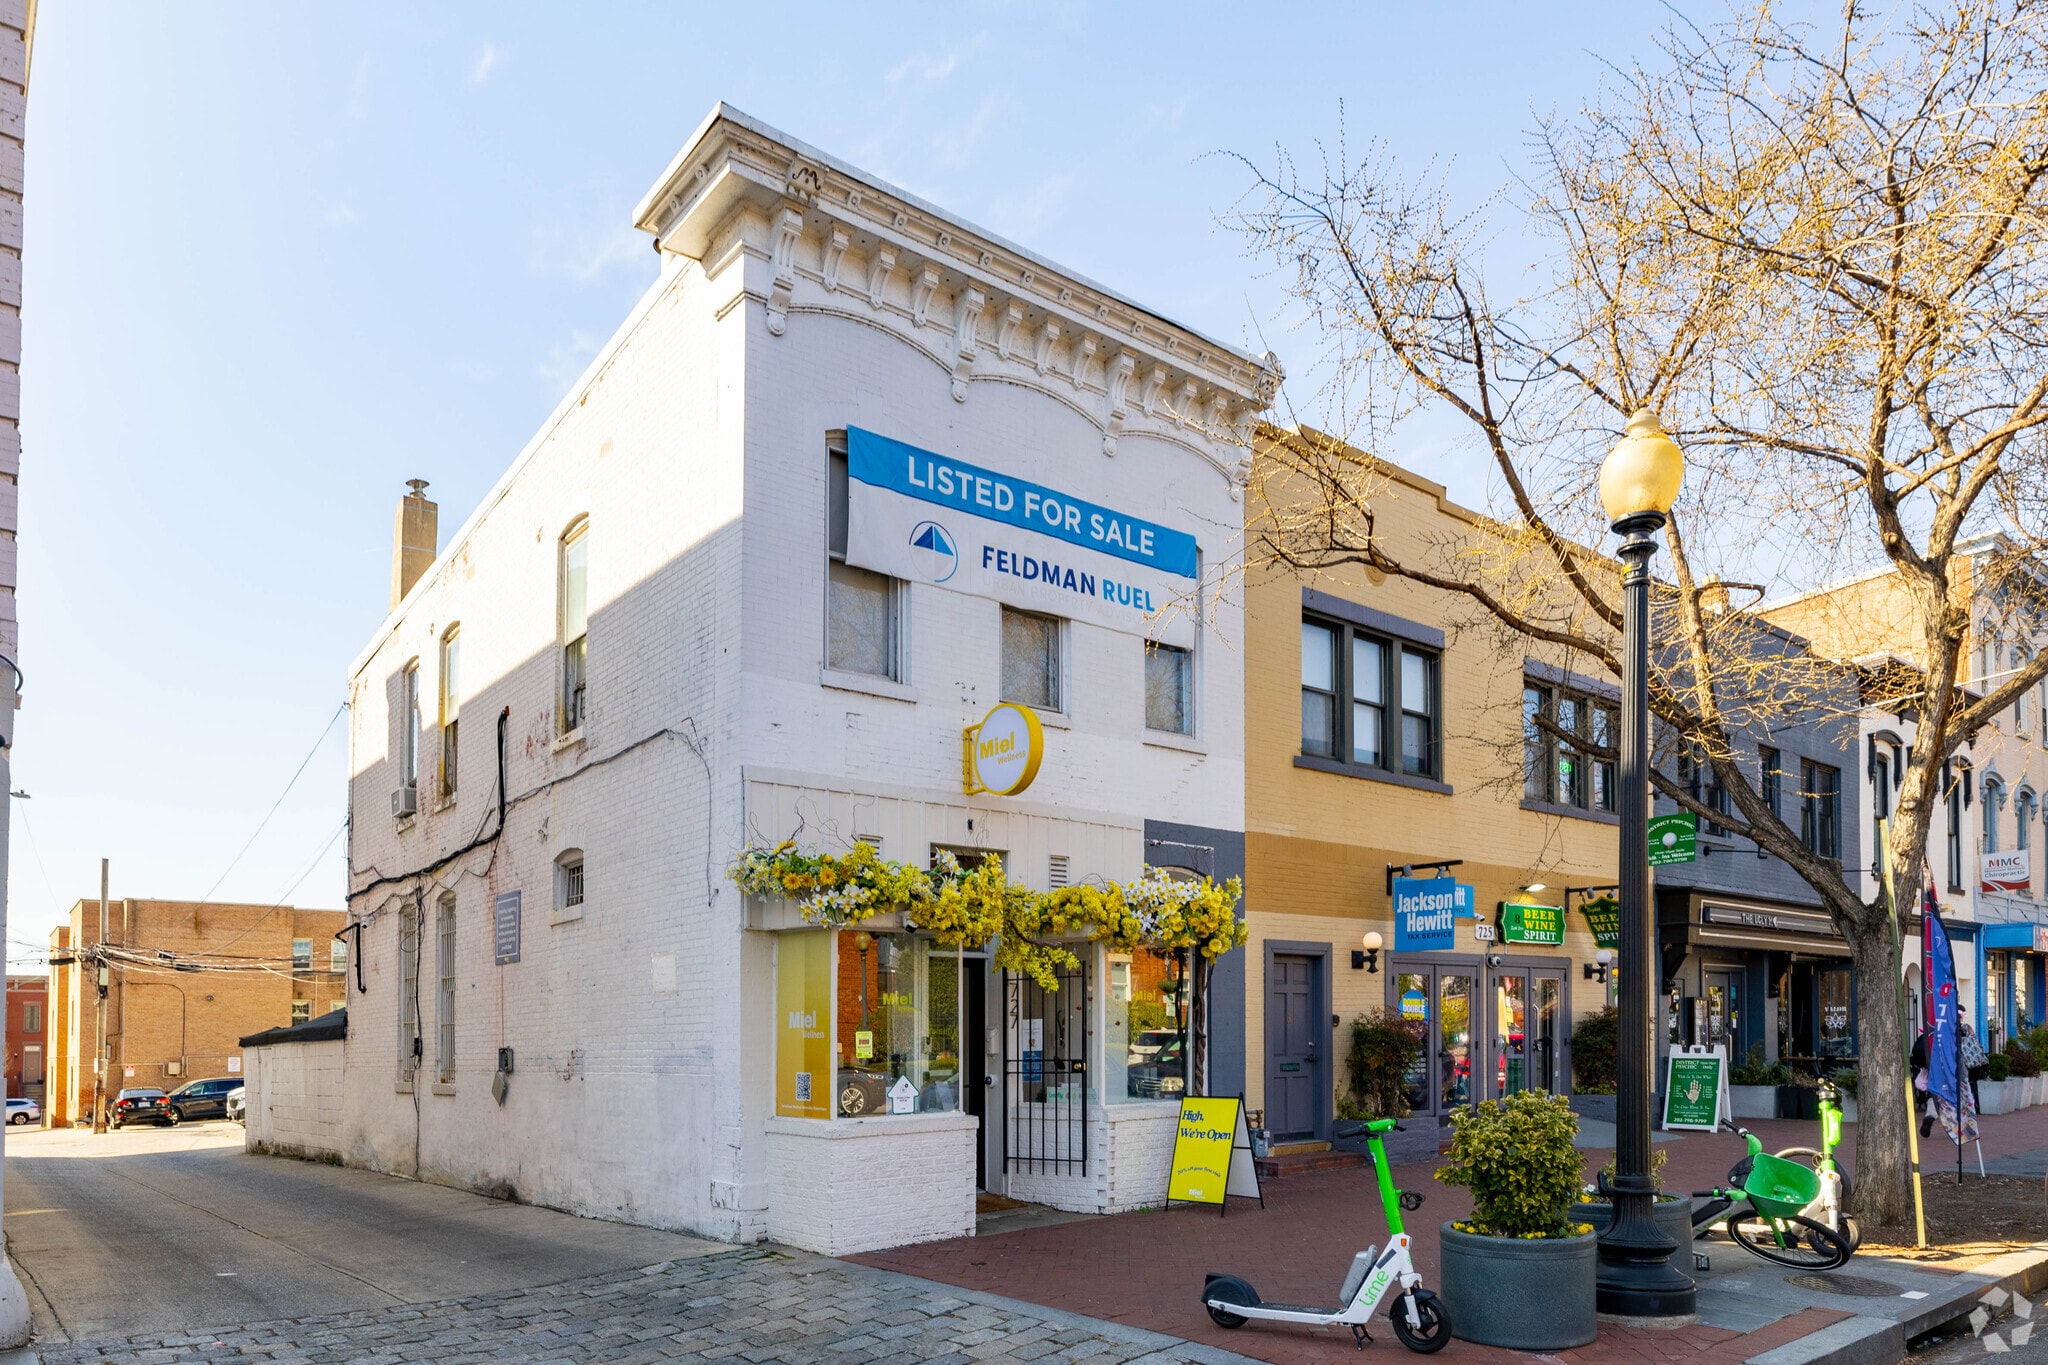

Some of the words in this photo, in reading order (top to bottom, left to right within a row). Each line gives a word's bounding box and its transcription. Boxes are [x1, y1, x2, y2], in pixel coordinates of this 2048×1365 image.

[908, 456, 1014, 512] LISTED
[1024, 491, 1081, 534] FOR
[1090, 514, 1155, 556] SALE
[982, 545, 1096, 597] FELDMAN
[1102, 579, 1155, 612] RUEL
[980, 731, 1015, 760] Miel
[1988, 857, 2020, 868] MMC
[1985, 870, 2026, 878] Chiropractic
[1397, 891, 1453, 913] Jackson
[1406, 909, 1453, 932] Hewitt
[1523, 909, 1556, 920] BEER
[1589, 913, 1619, 923] BEE
[1742, 912, 1754, 924] THE
[1524, 920, 1557, 931] WINE
[1592, 923, 1619, 932] WIN
[1422, 931, 1453, 939] SERVICE
[1478, 926, 1493, 938] 725
[1523, 930, 1557, 941] SPIRIT
[1597, 932, 1619, 941] SPI
[883, 990, 913, 1005] Miel
[1134, 990, 1157, 1002] Miel
[788, 1010, 817, 1029] Miel
[802, 1030, 825, 1039] Wellness
[1181, 1110, 1204, 1123] High,
[1180, 1127, 1206, 1139] We're
[1207, 1129, 1231, 1142] Open
